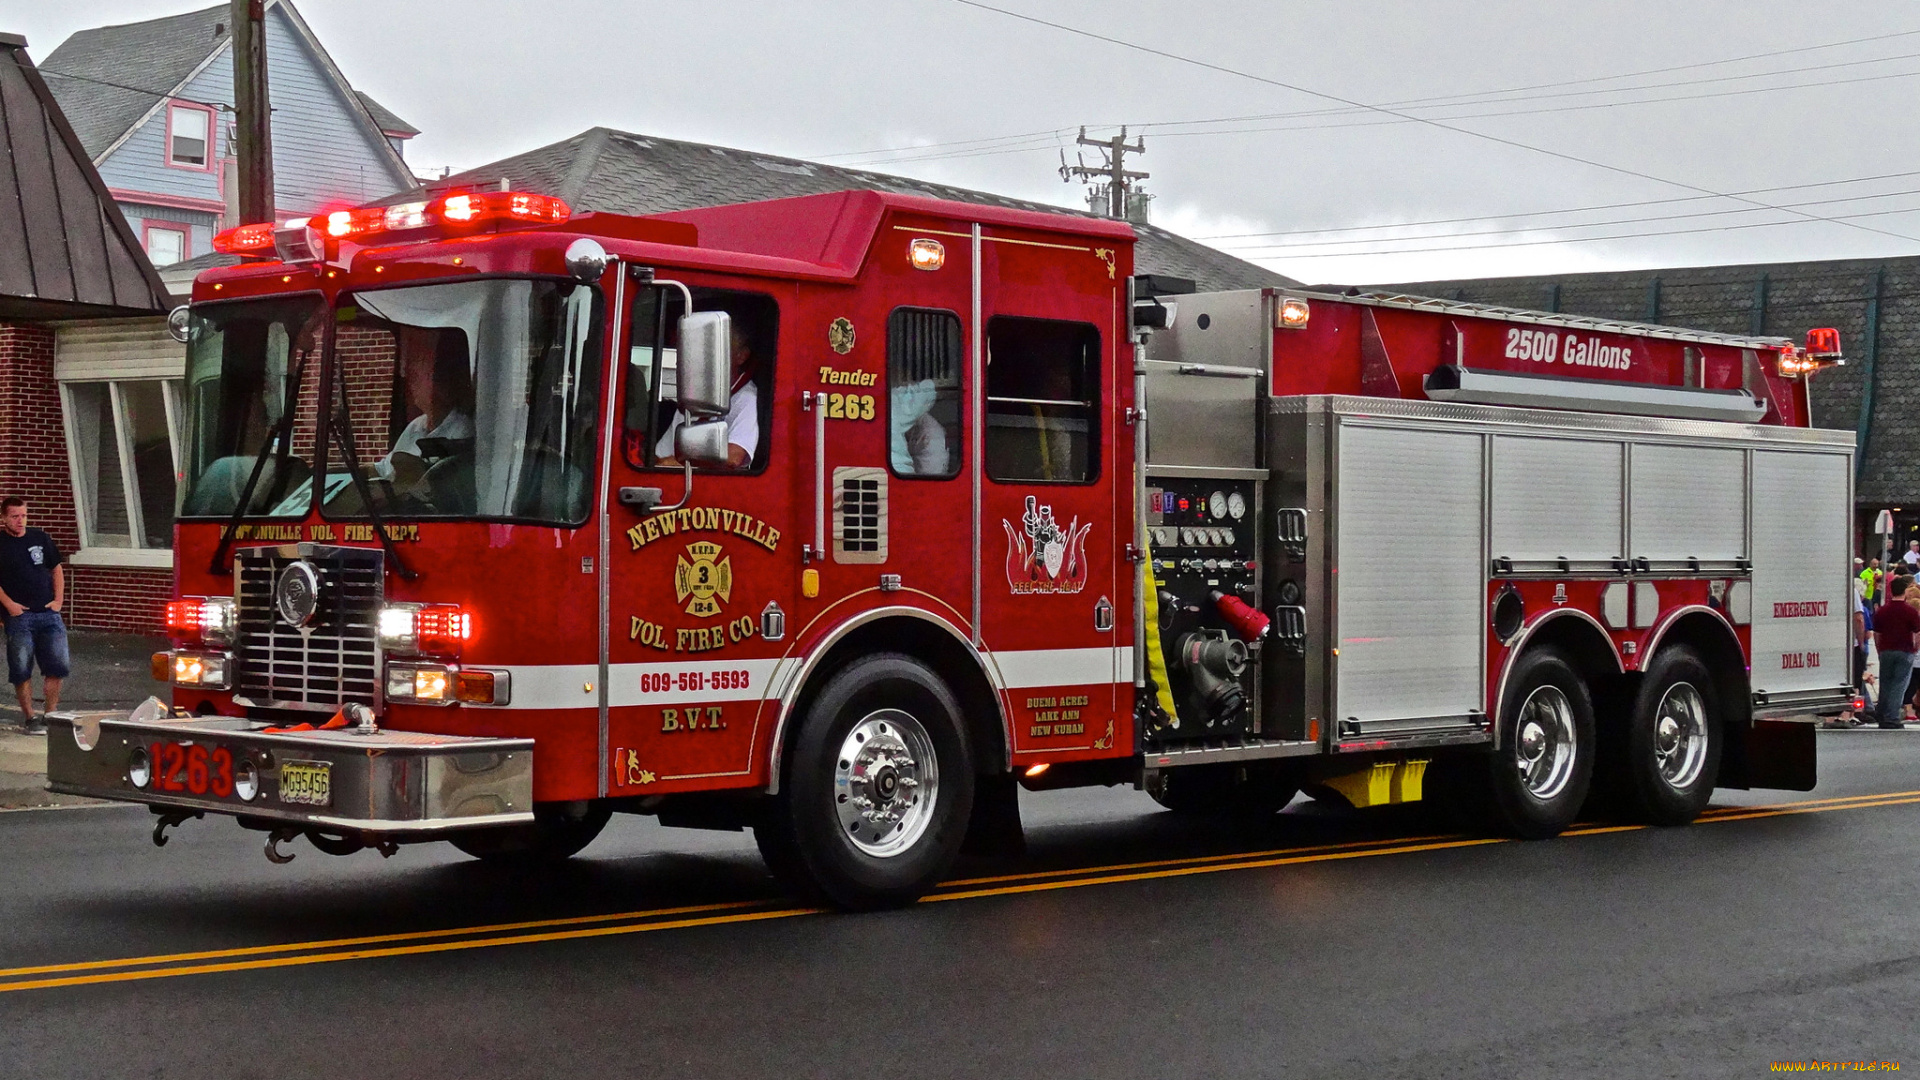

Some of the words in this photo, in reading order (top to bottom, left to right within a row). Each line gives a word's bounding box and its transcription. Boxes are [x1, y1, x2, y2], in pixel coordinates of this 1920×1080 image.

[1505, 328, 1558, 363] 2500
[1563, 334, 1632, 370] Gallons
[820, 366, 878, 387] Tender
[220, 525, 302, 540] NWTONVILLE
[310, 525, 337, 540] VOL.
[344, 525, 374, 540] FIRE
[627, 506, 781, 552] NEWTONVILLE
[698, 565, 709, 584] 3
[1773, 601, 1829, 618] EMERGENCY
[629, 615, 669, 650] VOL.
[675, 625, 725, 651] FIRE
[729, 615, 760, 643] CO.
[1782, 653, 1804, 669] DIAL
[1806, 651, 1820, 668] 911
[641, 670, 750, 693] 609-561-5593
[1026, 697, 1057, 709] BUENA
[1059, 695, 1089, 707] ACRES
[661, 707, 728, 731] B.V.T.
[1035, 711, 1059, 722] LAKE
[1061, 710, 1080, 721] ANN
[1030, 725, 1051, 737] NEW
[151, 741, 233, 798] 1263
[282, 770, 328, 794] MG95456
